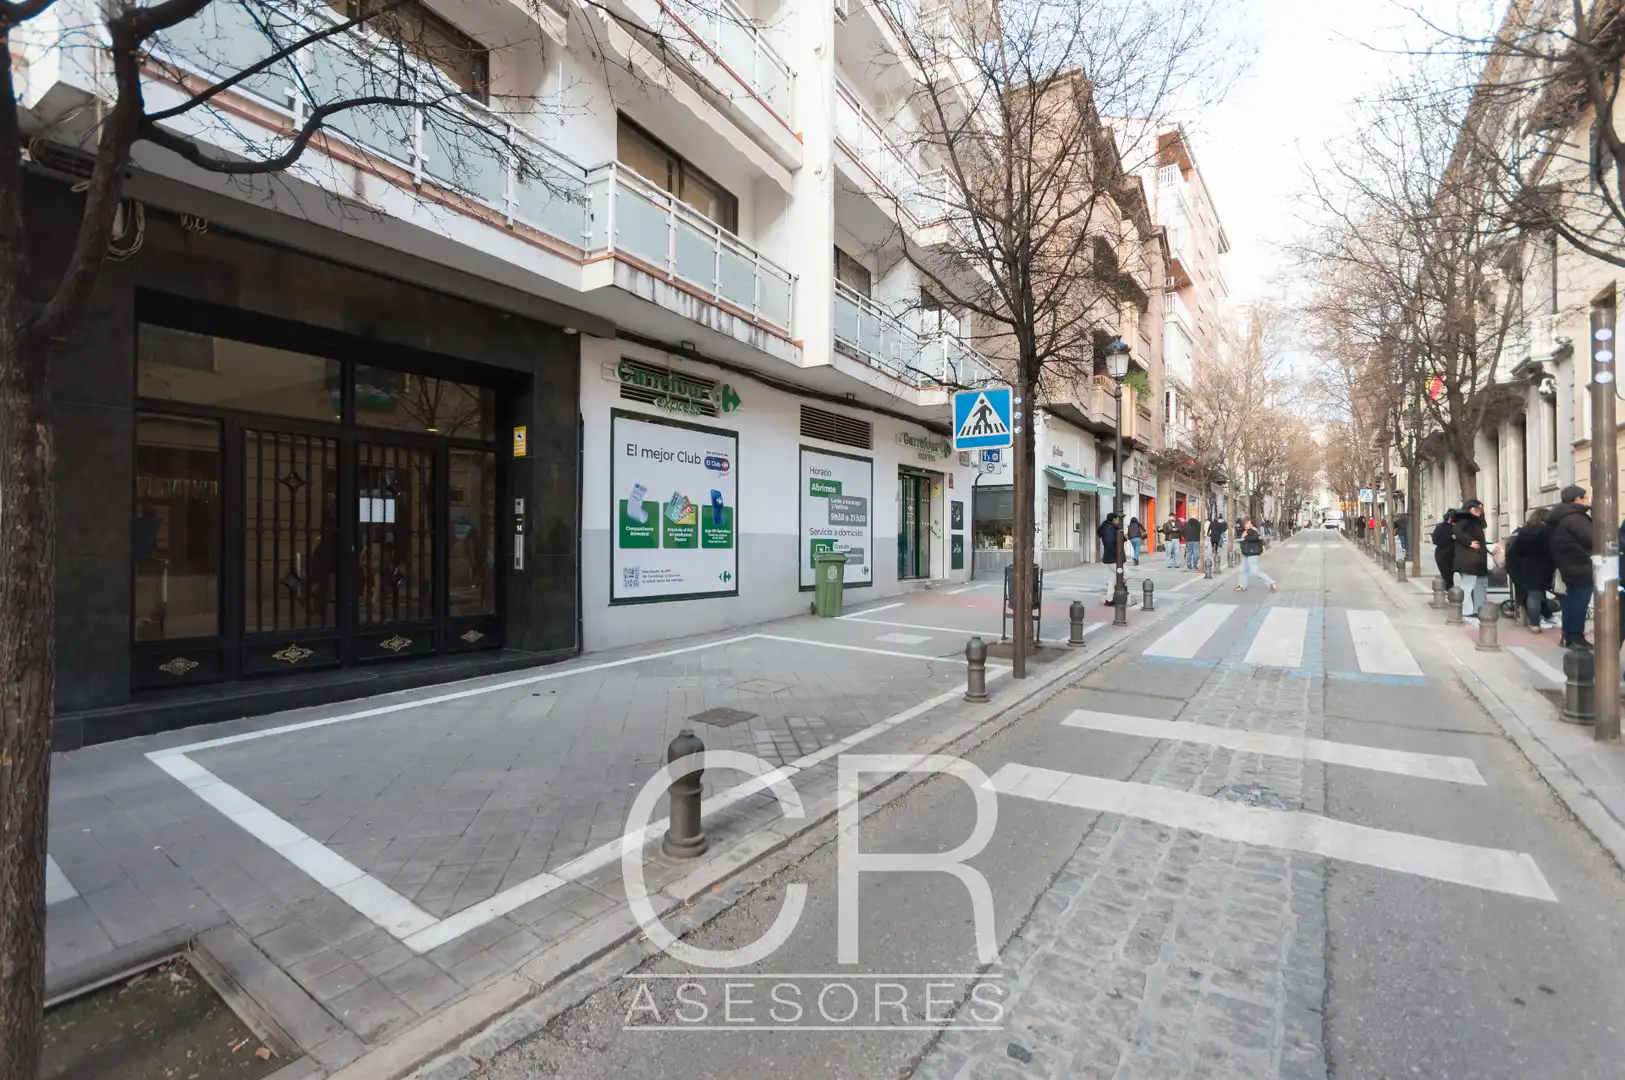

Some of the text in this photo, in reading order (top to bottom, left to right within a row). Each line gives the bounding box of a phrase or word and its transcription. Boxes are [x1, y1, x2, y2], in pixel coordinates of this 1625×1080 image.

[617, 359, 706, 400] Carrefour
[655, 397, 702, 416] express
[903, 432, 940, 452] Carrefour
[626, 443, 702, 465] El mejor Club
[809, 466, 832, 477] Horario
[811, 483, 836, 493] Abrimos
[809, 527, 833, 536] Servicio
[838, 528, 864, 537] domicilio
